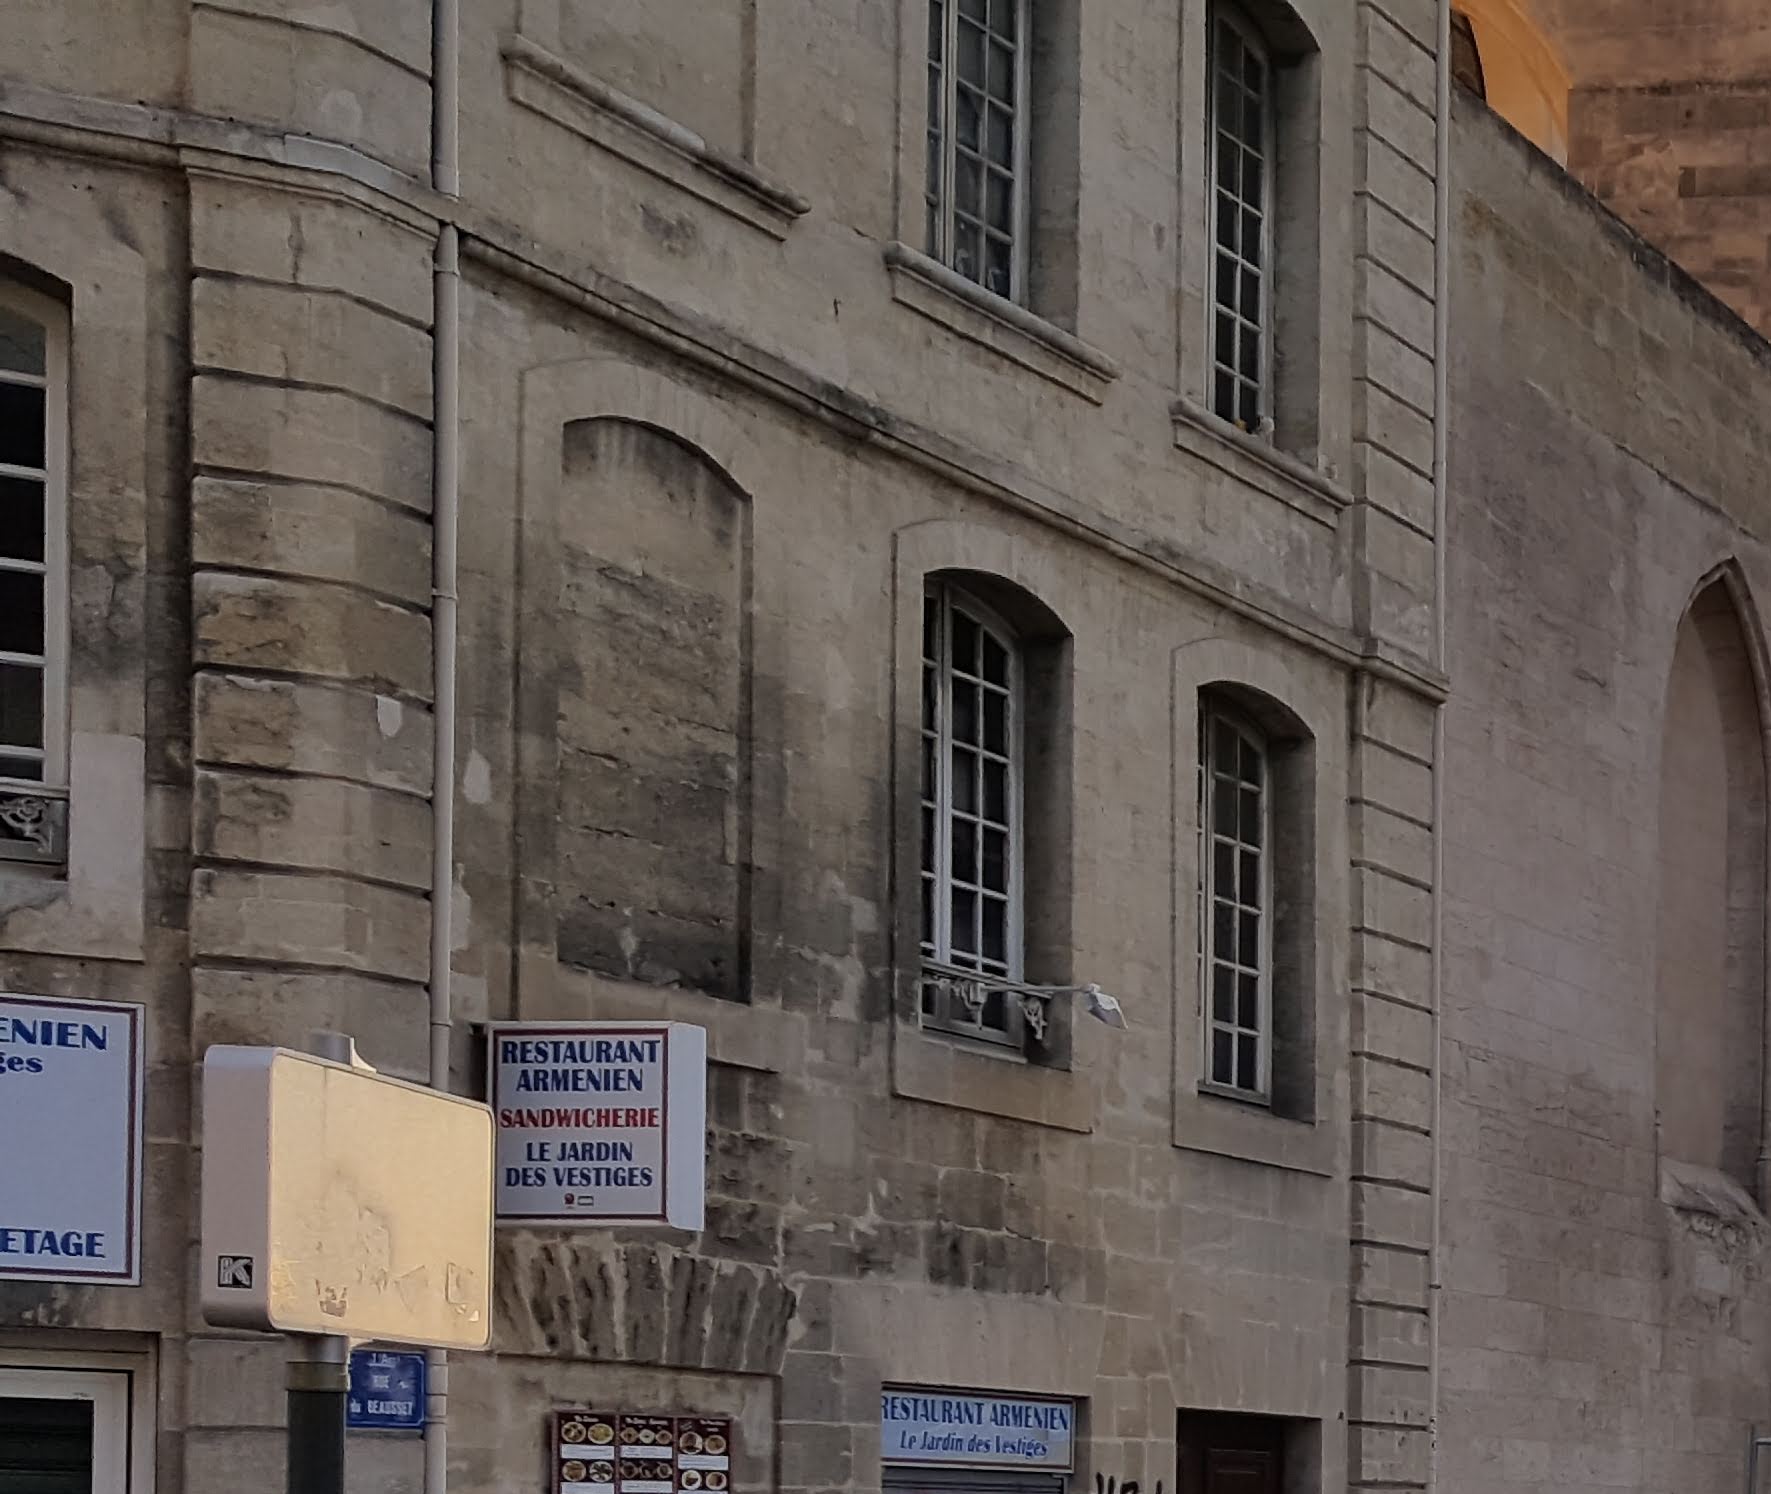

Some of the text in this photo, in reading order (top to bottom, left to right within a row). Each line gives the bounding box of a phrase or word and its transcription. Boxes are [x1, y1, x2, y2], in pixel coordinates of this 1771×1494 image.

[501, 1040, 661, 1065] RESTAURANT
[515, 1068, 643, 1093] ARMENIEN
[500, 1107, 660, 1129] SANDWICHERIE
[525, 1141, 633, 1162] LE JARDIN
[505, 1166, 653, 1188] DES VESTIGES
[0, 1226, 106, 1259] ETAGE
[881, 1396, 1069, 1431] RESTAURANT ARMENIEN
[900, 1430, 1048, 1459] Le Jardin des Vestiges
